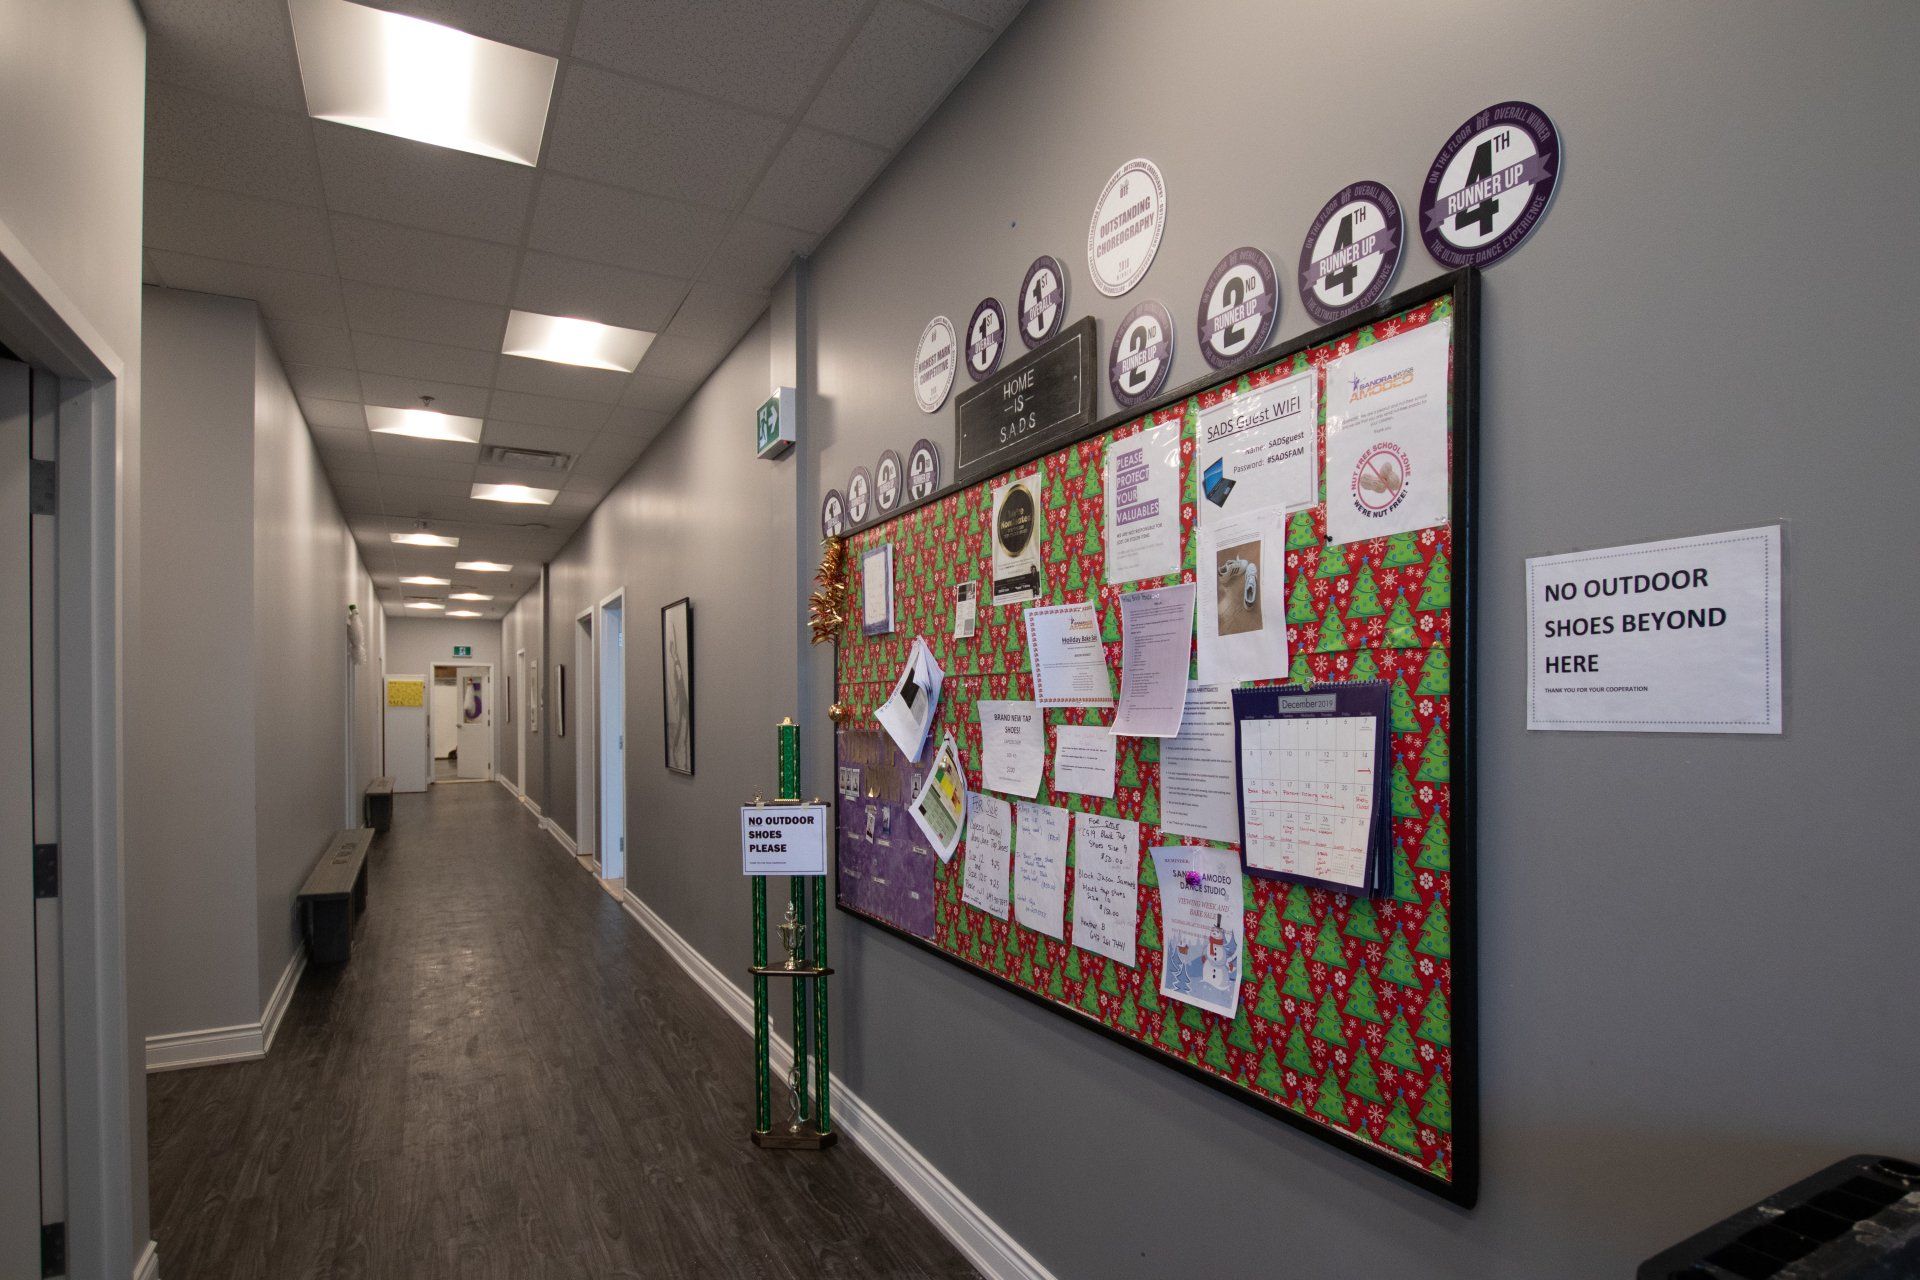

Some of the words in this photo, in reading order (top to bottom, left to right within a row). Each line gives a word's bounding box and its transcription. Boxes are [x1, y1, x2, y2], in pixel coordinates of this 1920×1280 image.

[1429, 174, 1438, 184] ON
[1436, 154, 1450, 170] THE
[1448, 126, 1472, 152] FLOOR
[1494, 106, 1526, 120] OVERALL
[1526, 112, 1550, 142] WINNER
[1354, 185, 1380, 198] OVERALL
[1379, 191, 1397, 218] WINNER
[1448, 174, 1502, 215] RUNNER
[1505, 164, 1524, 188] UP
[1100, 196, 1150, 238] OUTSTANDING
[1430, 240, 1444, 256] THE
[1441, 250, 1475, 264] ULTIMATE
[1476, 244, 1502, 263] DANCE
[1503, 194, 1546, 248] EXPERIENCE
[1096, 212, 1155, 258] CHOREOGRAPHY
[1320, 243, 1360, 277] RUNNER
[1362, 236, 1376, 254] UP
[1360, 263, 1392, 308] EXPERIENCE
[1029, 294, 1052, 320] OVERALL
[1214, 304, 1245, 332] RUNNER
[1246, 298, 1258, 316] UP
[1122, 350, 1147, 373] RUNNER
[1148, 346, 1156, 360] UP
[1003, 368, 1035, 400] HOME
[1360, 374, 1392, 390] SANDRA
[1207, 419, 1233, 440] SADS
[1236, 408, 1270, 429] Guest
[1272, 396, 1300, 418] WIFI
[1117, 452, 1142, 470] PLEASE
[1233, 459, 1264, 474] Password:
[1266, 446, 1304, 464] #SADSFAM
[1356, 449, 1371, 470] FREE
[1372, 442, 1402, 456] SCHOOL
[1400, 451, 1412, 478] ZONE
[1117, 468, 1149, 487] PROTECT
[1117, 489, 1138, 504] YOUR
[1372, 509, 1388, 519] NUT
[1388, 489, 1408, 512] FREE!
[1116, 501, 1159, 523] VALUABLES
[1544, 582, 1578, 602] NO
[1584, 568, 1708, 598] OUTDOOR
[1544, 614, 1614, 638] SHOES
[1622, 607, 1726, 633] BEYOND
[1062, 636, 1081, 644] Holiday
[1545, 654, 1600, 674] HERE
[1282, 698, 1318, 709] December
[1318, 700, 1334, 708] 2019
[994, 713, 1010, 722] BRAND
[1010, 714, 1022, 722] NEW
[1022, 714, 1032, 722] TAP
[748, 816, 762, 826] NO
[765, 816, 814, 825] OUTDOOR
[748, 830, 782, 839] SHOES
[749, 844, 787, 853] PLEASE
[1180, 881, 1202, 893] DANCE
[1204, 885, 1226, 896] STUDIO
[1202, 873, 1232, 885] AMODEO
[1178, 897, 1200, 907] VIEWING
[1202, 901, 1217, 910] WEEK
[1217, 905, 1230, 913] AND
[1190, 909, 1203, 917] BAKE
[1203, 911, 1217, 920] SALE
